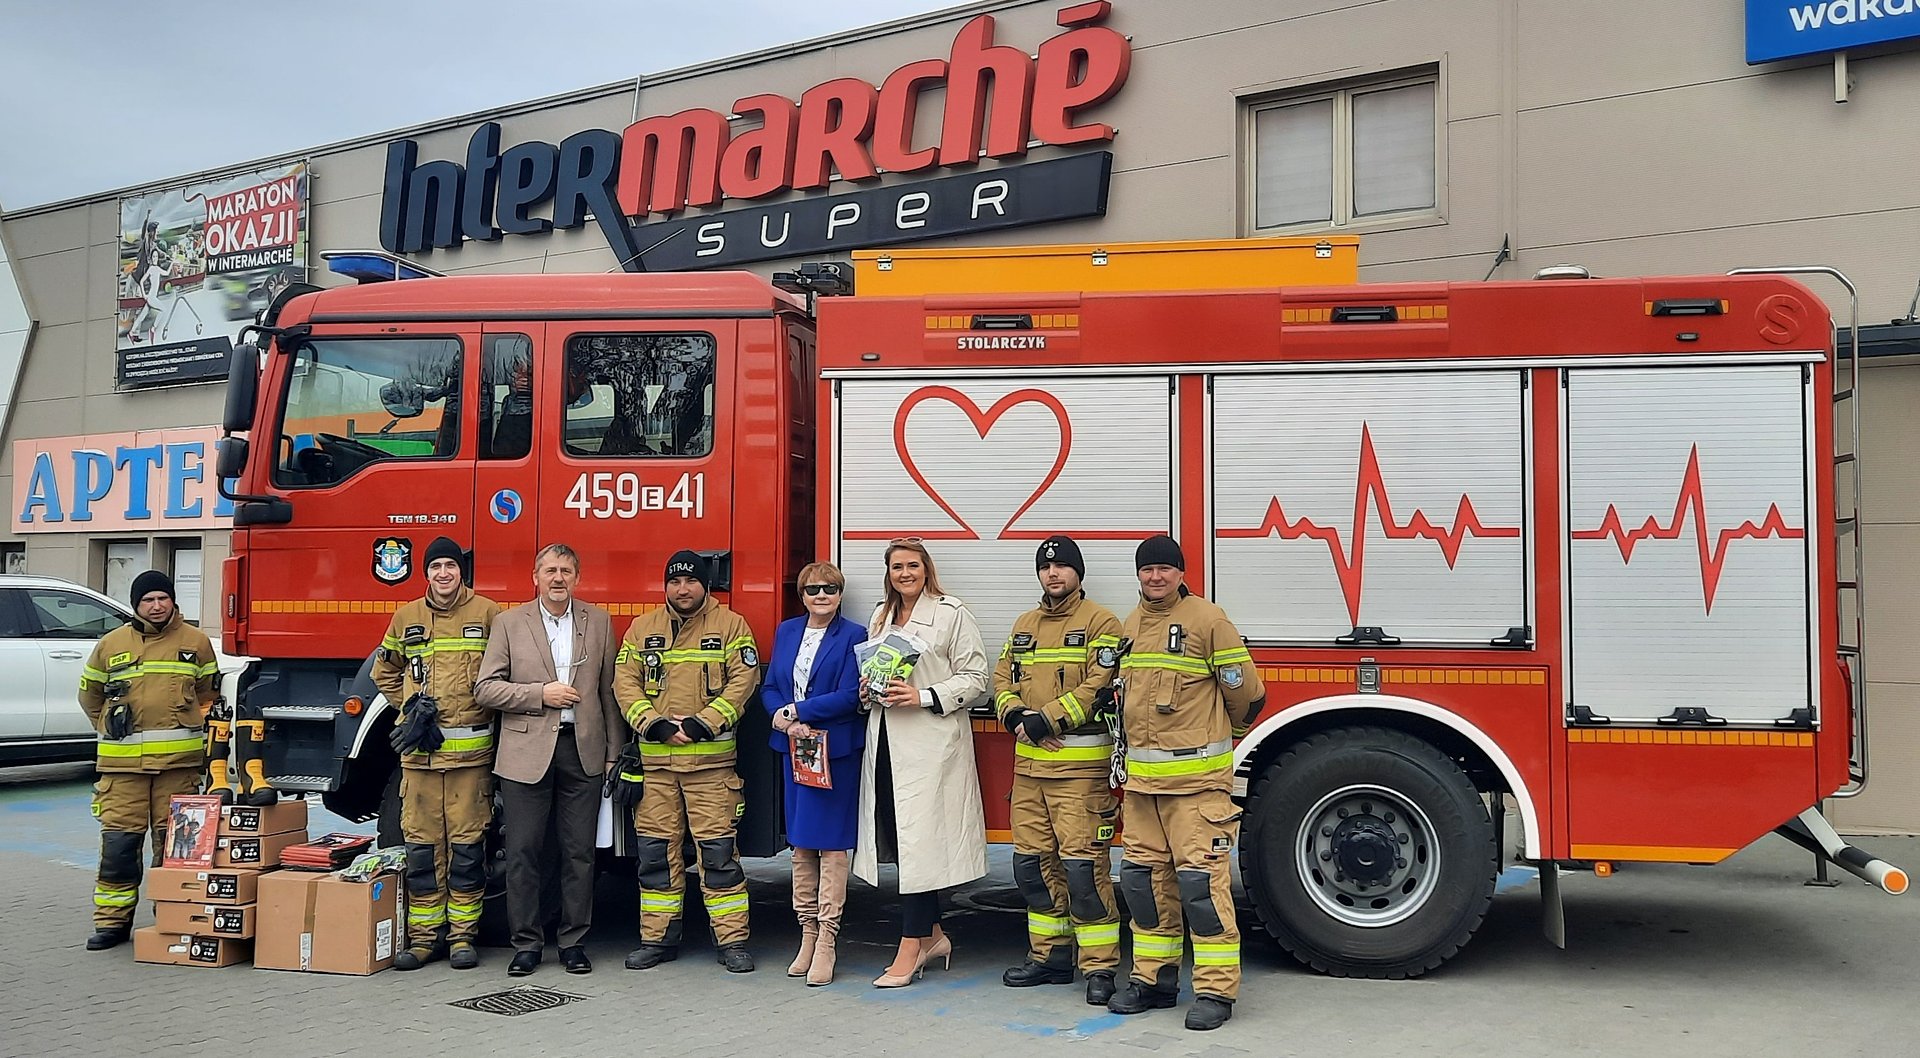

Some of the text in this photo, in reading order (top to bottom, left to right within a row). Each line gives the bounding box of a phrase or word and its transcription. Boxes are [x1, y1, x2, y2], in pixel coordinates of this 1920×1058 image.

[1789, 0, 1920, 32] waka
[208, 181, 295, 223] MARATON
[696, 179, 1010, 257] SUPER
[205, 209, 294, 256] OKAZJI
[208, 244, 293, 272] W INTERMARCHÉ
[957, 336, 1045, 350] STOLARCZYK
[414, 514, 457, 524] 18.340
